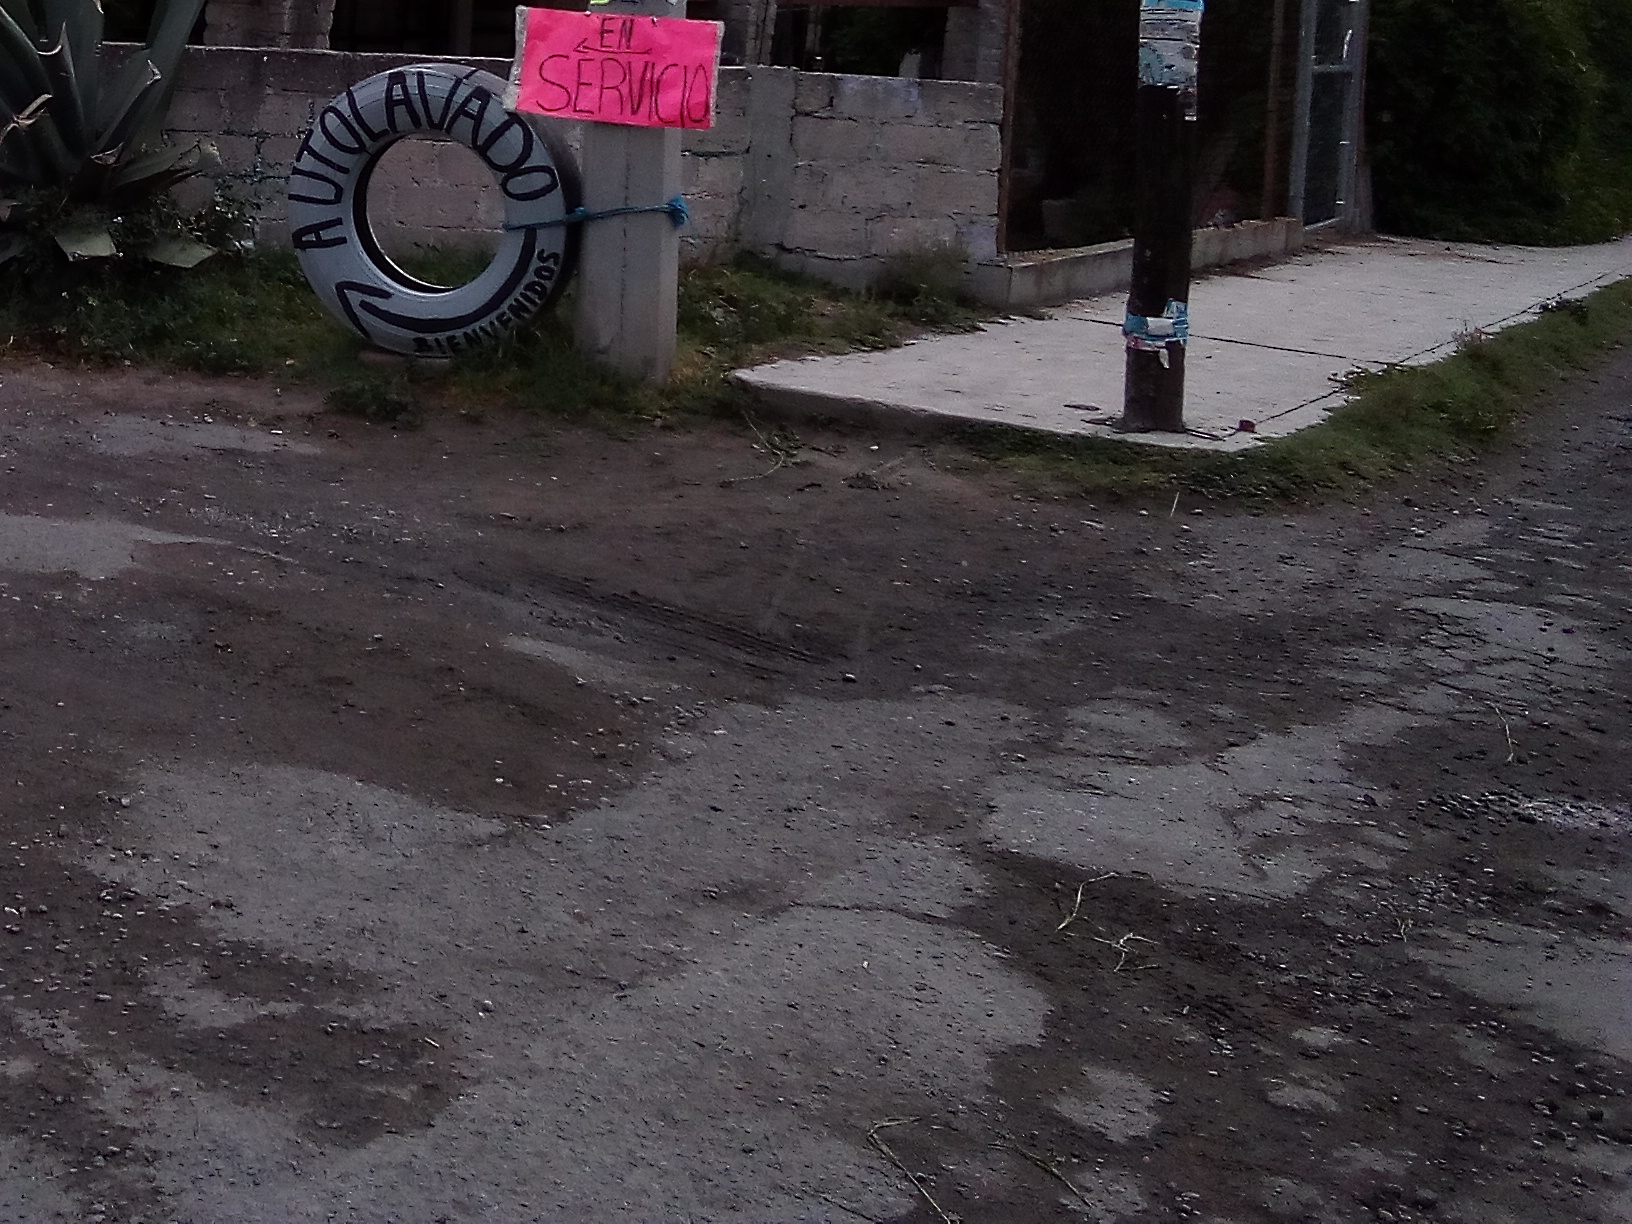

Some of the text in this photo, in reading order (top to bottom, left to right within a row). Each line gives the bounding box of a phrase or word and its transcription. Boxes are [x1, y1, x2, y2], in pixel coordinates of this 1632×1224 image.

[599, 16, 635, 49] EN
[535, 53, 711, 125] SERVICIO
[287, 69, 561, 252] AUTOLAVADO
[412, 247, 561, 354] BIENVENIDOS
